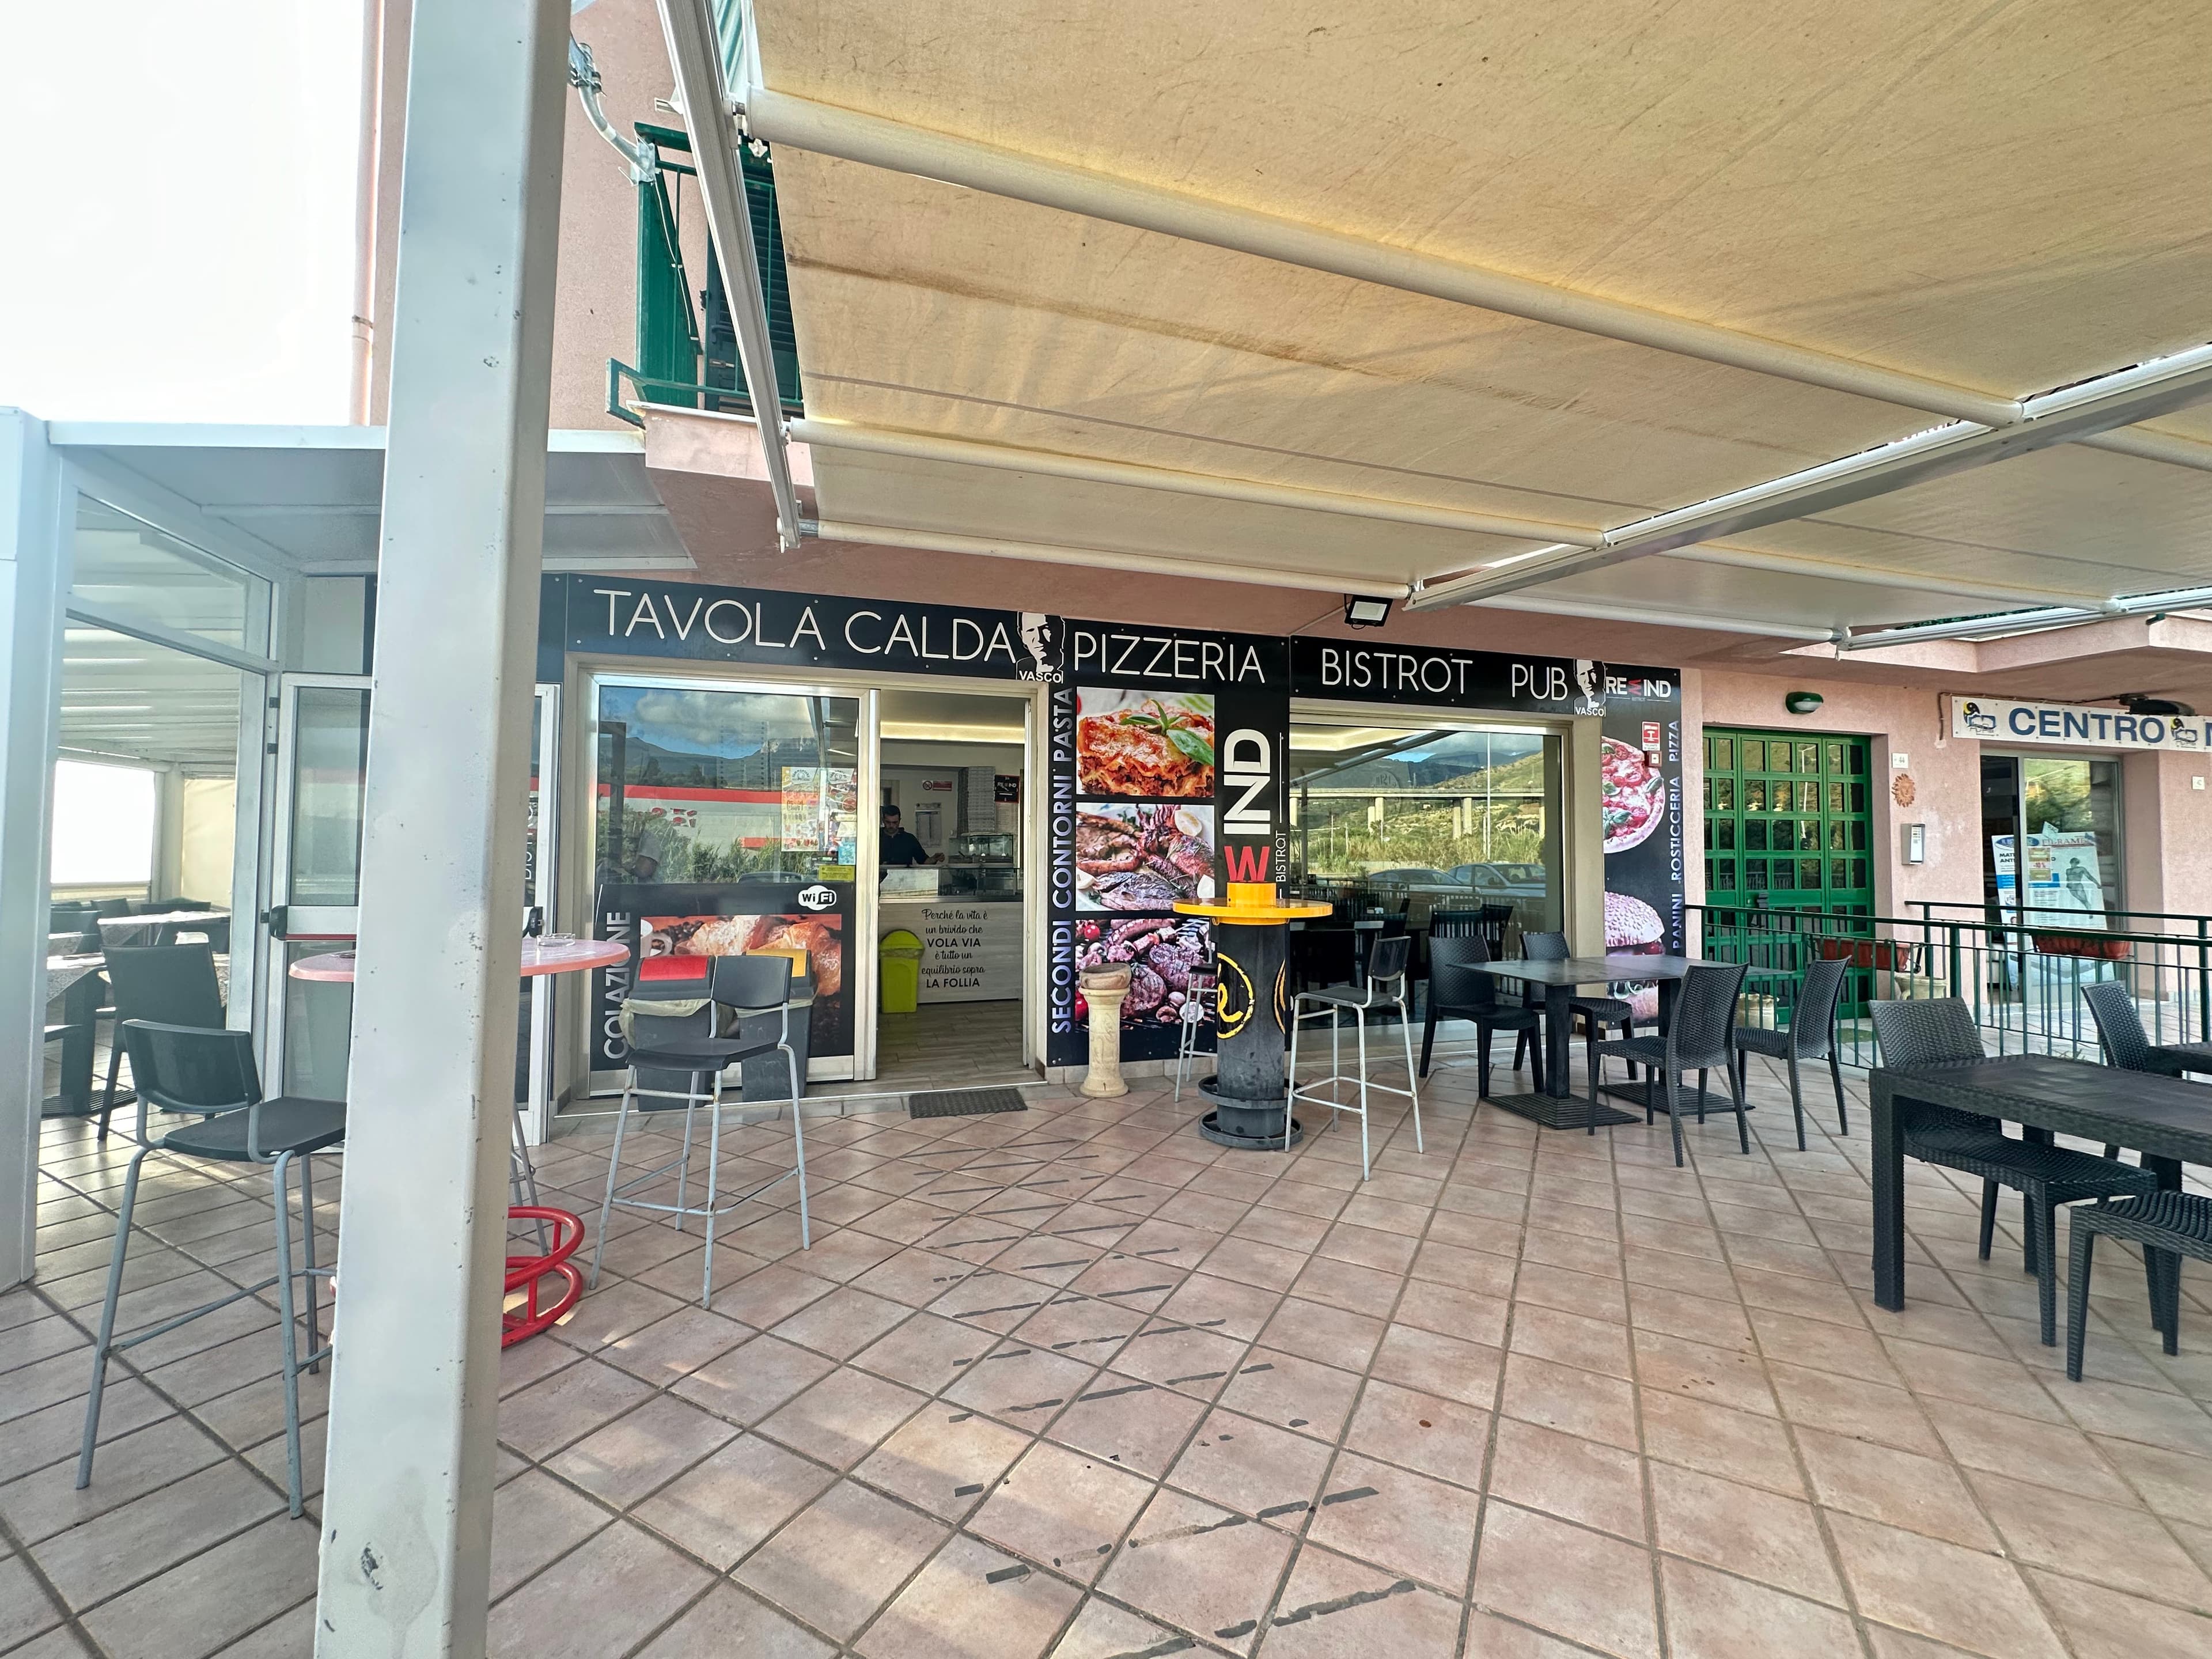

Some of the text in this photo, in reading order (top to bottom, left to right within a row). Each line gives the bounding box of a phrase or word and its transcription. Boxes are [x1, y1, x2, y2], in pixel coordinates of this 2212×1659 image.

[593, 589, 1016, 664] TAVOLA CALDA
[1074, 631, 1265, 684] PIZZERIA
[1019, 670, 1062, 683] VASCO
[1321, 649, 1568, 701] BISTROT PUB
[1575, 706, 1605, 717] VASCO
[2008, 707, 2165, 744] CENTRO
[1668, 720, 1683, 949] PANINI ROSTICCERIA PIZZA
[1052, 687, 1073, 1034] SECONDI CONTORNI PASTA
[1275, 830, 1286, 882] BISTROT
[922, 908, 988, 920] Perché la vita è
[939, 925, 967, 934] brivido
[969, 925, 983, 934] che
[927, 938, 981, 948] VOLA VIA
[935, 951, 940, 960] è
[941, 950, 960, 960] tutto
[922, 964, 986, 978] equilibrio sopra
[926, 978, 980, 988] LA FOLLIA
